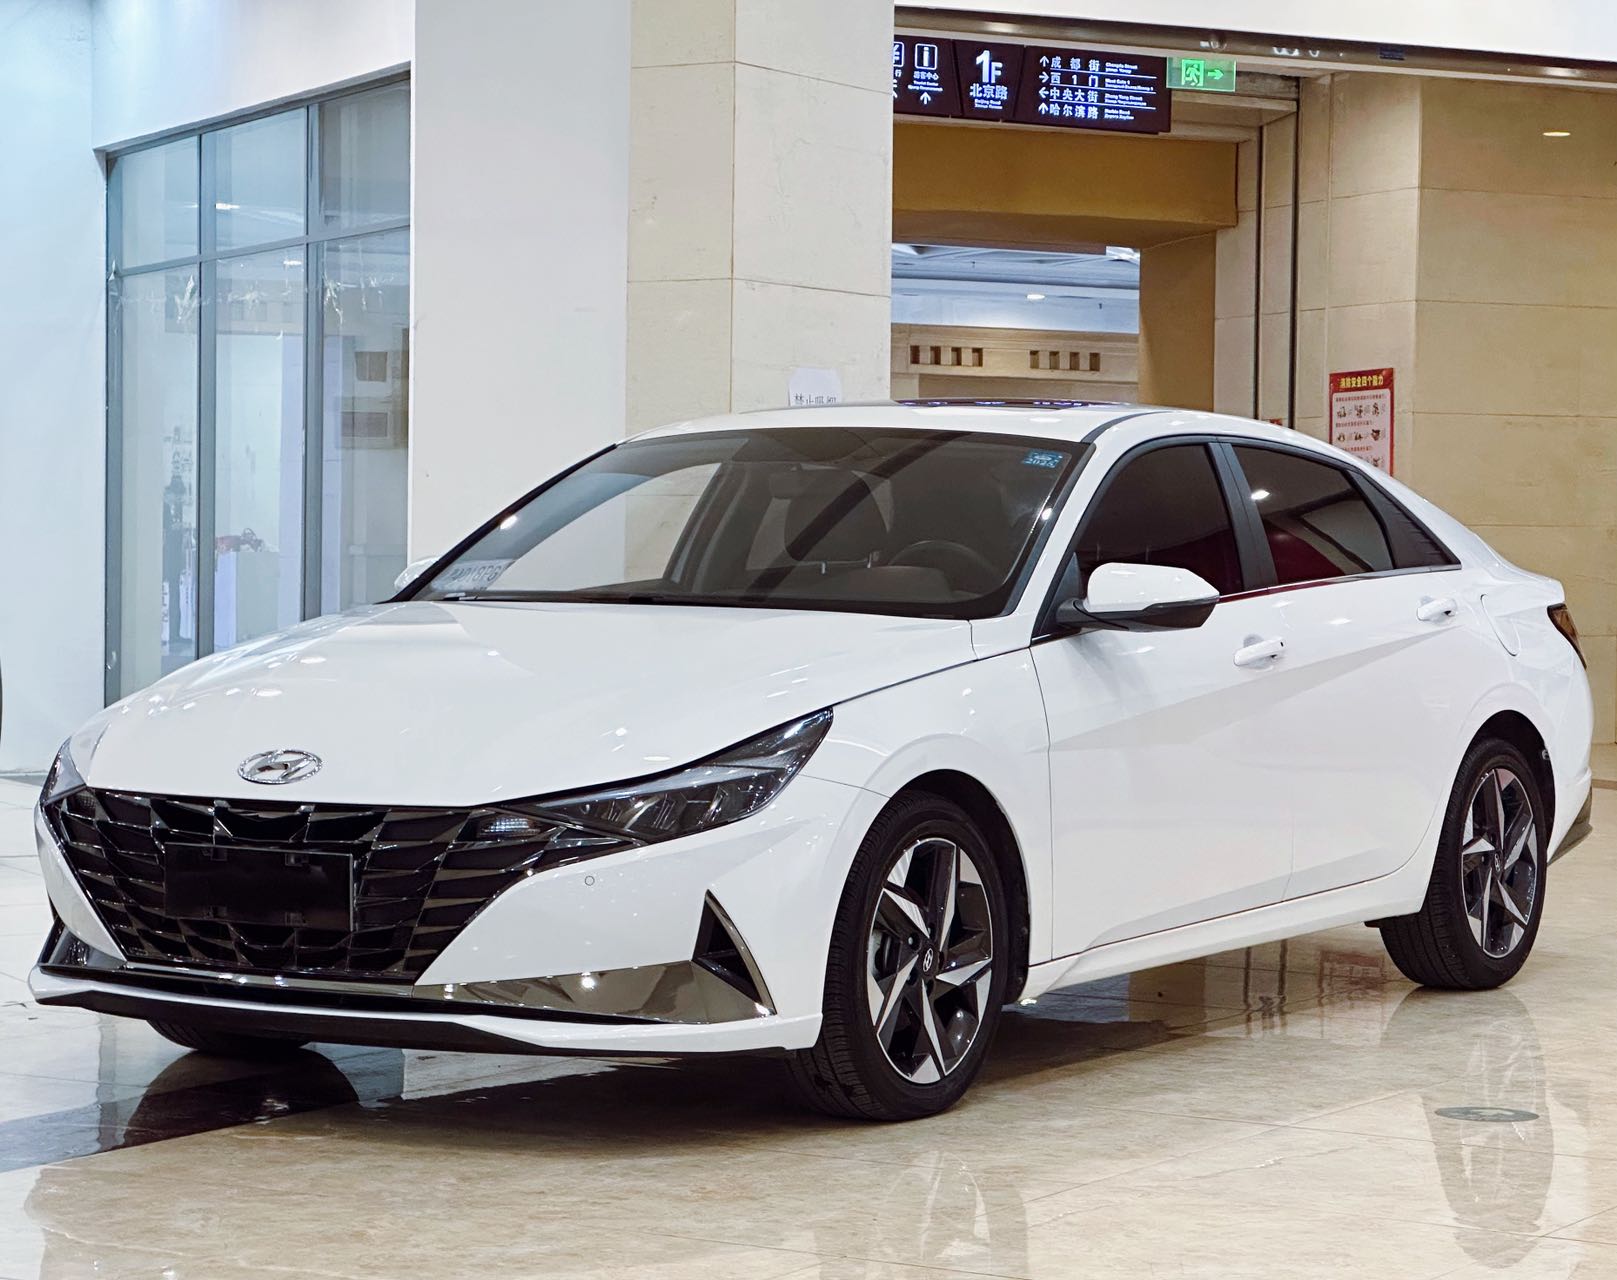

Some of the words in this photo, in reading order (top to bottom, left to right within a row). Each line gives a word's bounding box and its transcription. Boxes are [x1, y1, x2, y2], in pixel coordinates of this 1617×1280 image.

[976, 50, 1003, 83] 1F
[1051, 56, 1100, 71] 成都街
[970, 83, 1008, 100] 北京路
[1050, 87, 1098, 102] 中央大街
[1050, 103, 1098, 119] 哈尔滨路
